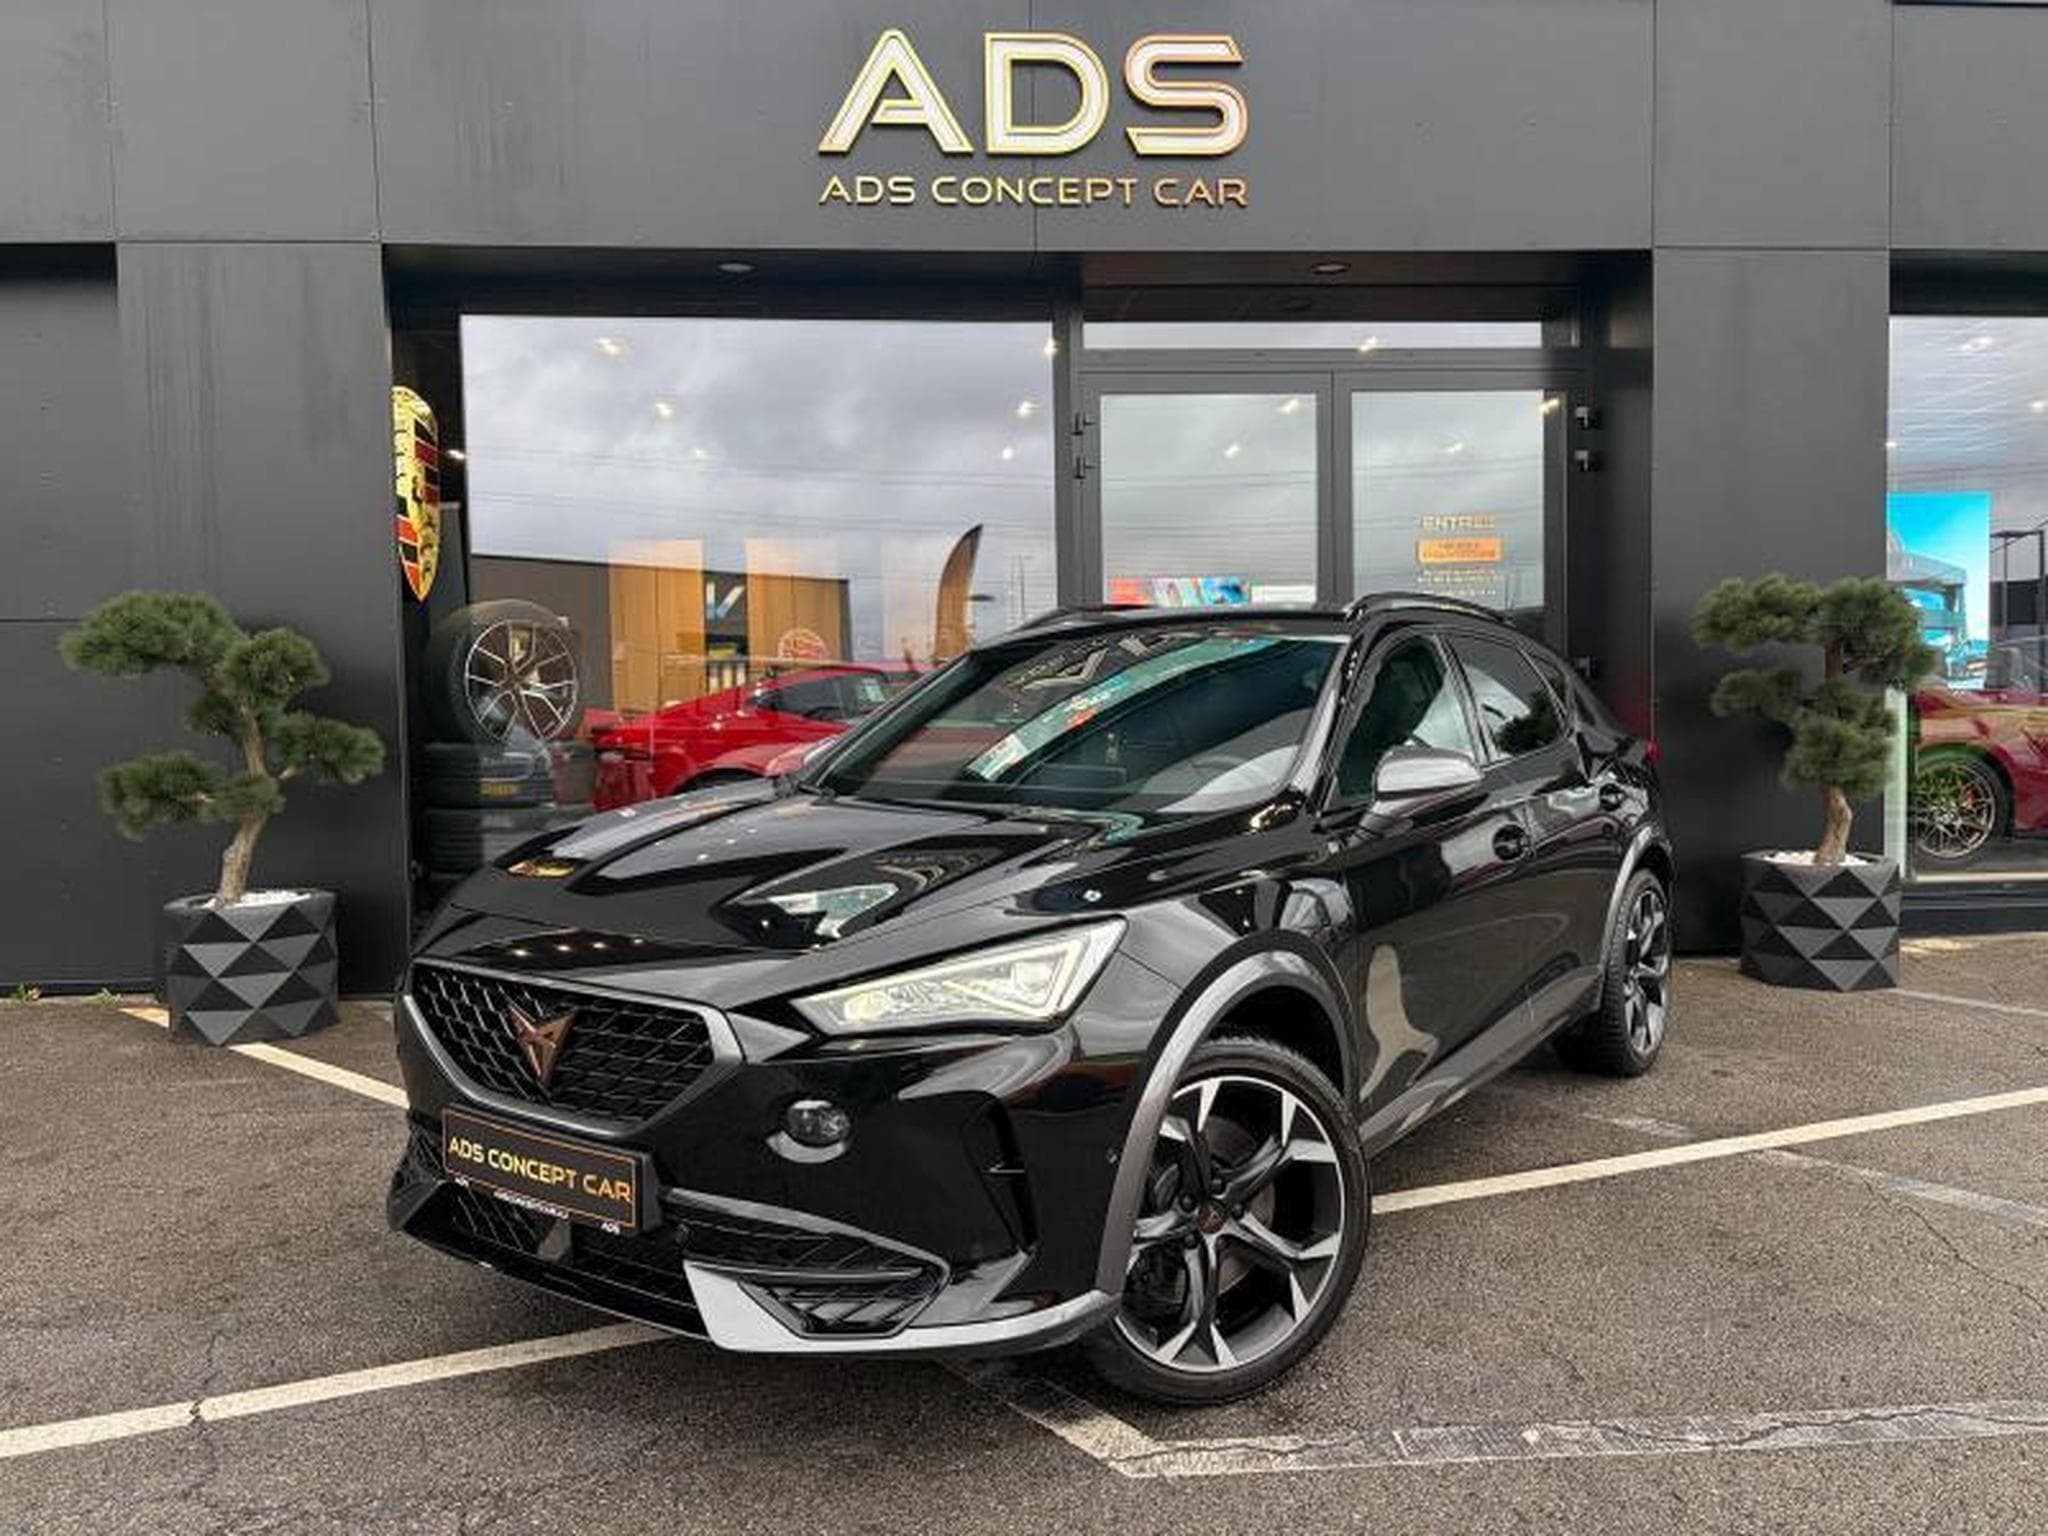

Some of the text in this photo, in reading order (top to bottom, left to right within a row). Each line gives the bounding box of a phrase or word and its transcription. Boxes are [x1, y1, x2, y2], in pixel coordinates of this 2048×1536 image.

[818, 27, 1250, 156] ADS
[818, 174, 1249, 207] ADS CONCEPT CAR
[449, 1135, 633, 1203] ADS CONCEPT CAR
